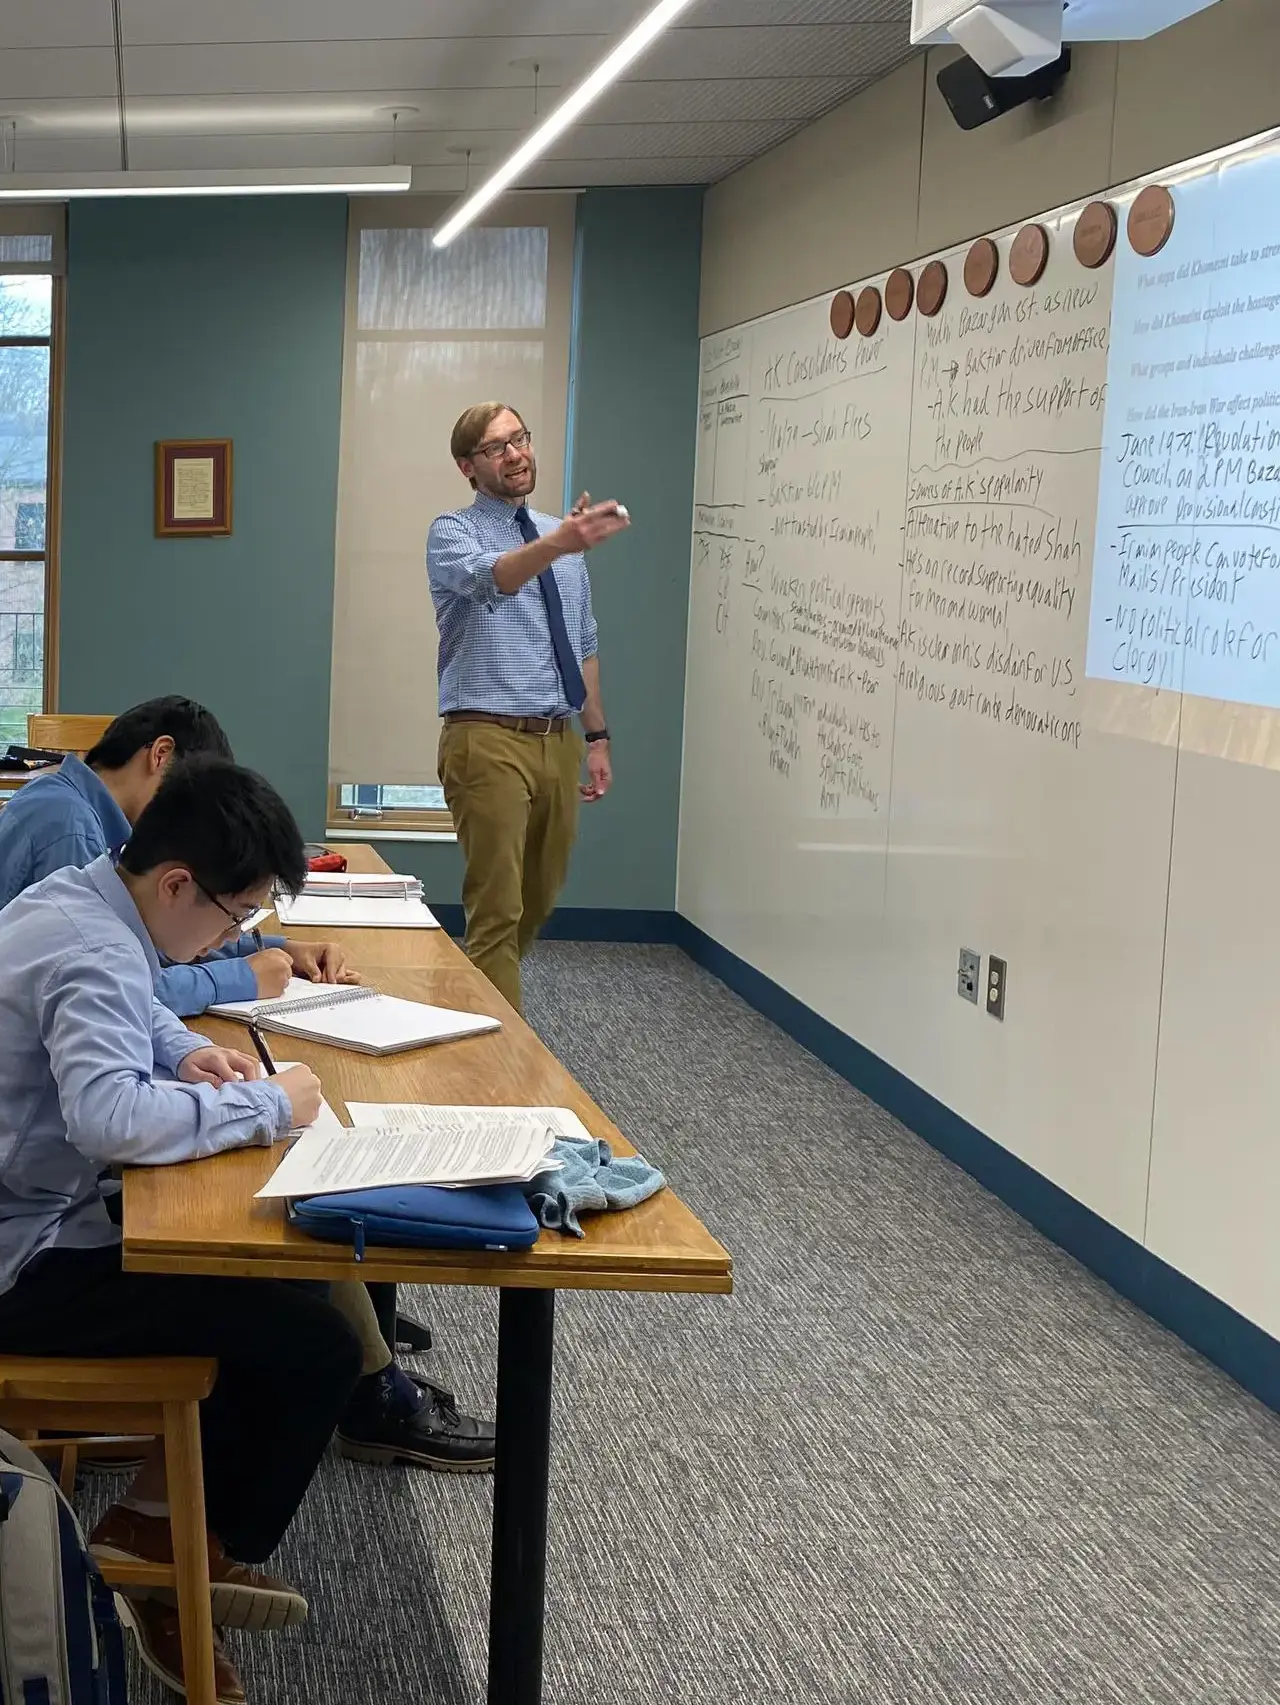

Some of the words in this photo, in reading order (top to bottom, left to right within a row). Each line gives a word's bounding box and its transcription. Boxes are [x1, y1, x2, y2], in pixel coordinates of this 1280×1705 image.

[1177, 261, 1191, 280] did
[1231, 249, 1248, 267] take
[1250, 247, 1259, 261] to
[1151, 315, 1164, 331] did
[1203, 302, 1230, 323] exploit
[1232, 297, 1245, 315] the
[1149, 361, 1176, 379] groups
[1176, 354, 1193, 371] and
[1193, 347, 1238, 369] individuals
[963, 379, 991, 417] had
[997, 372, 1022, 419] the
[1022, 376, 1089, 419] support
[1090, 383, 1108, 411] of
[1210, 397, 1227, 414] War
[1227, 394, 1252, 415] affect
[964, 511, 978, 546] to
[981, 509, 1004, 551] the
[1006, 509, 1046, 558] hated
[1044, 517, 1082, 577] Shah
[1114, 603, 1137, 635] No
